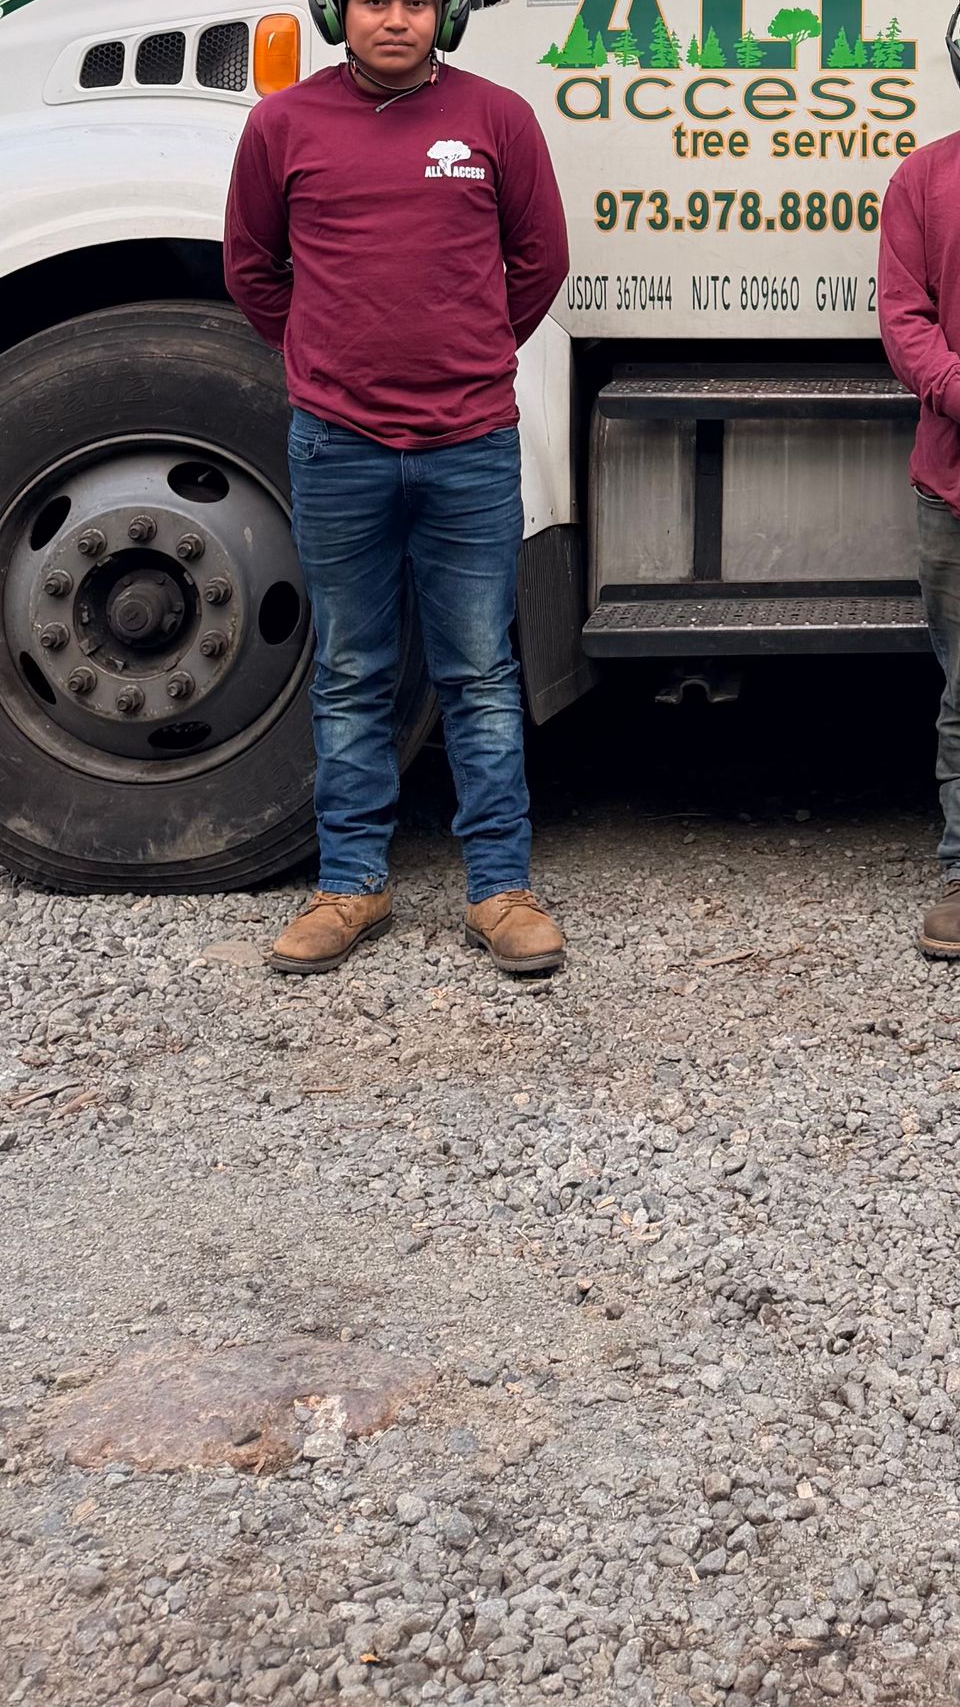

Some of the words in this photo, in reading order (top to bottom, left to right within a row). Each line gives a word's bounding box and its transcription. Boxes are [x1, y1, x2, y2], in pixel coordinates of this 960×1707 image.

[555, 75, 918, 122] access
[672, 122, 750, 159] tree
[770, 122, 918, 159] service
[424, 165, 443, 177] ALL
[452, 165, 486, 180] ACCESS
[594, 189, 881, 232] 973.978.8806
[567, 275, 609, 310] USDOT
[616, 275, 672, 310] 3670444
[692, 275, 731, 311] NJTC
[740, 275, 800, 311] 809660
[816, 276, 858, 311] GVW
